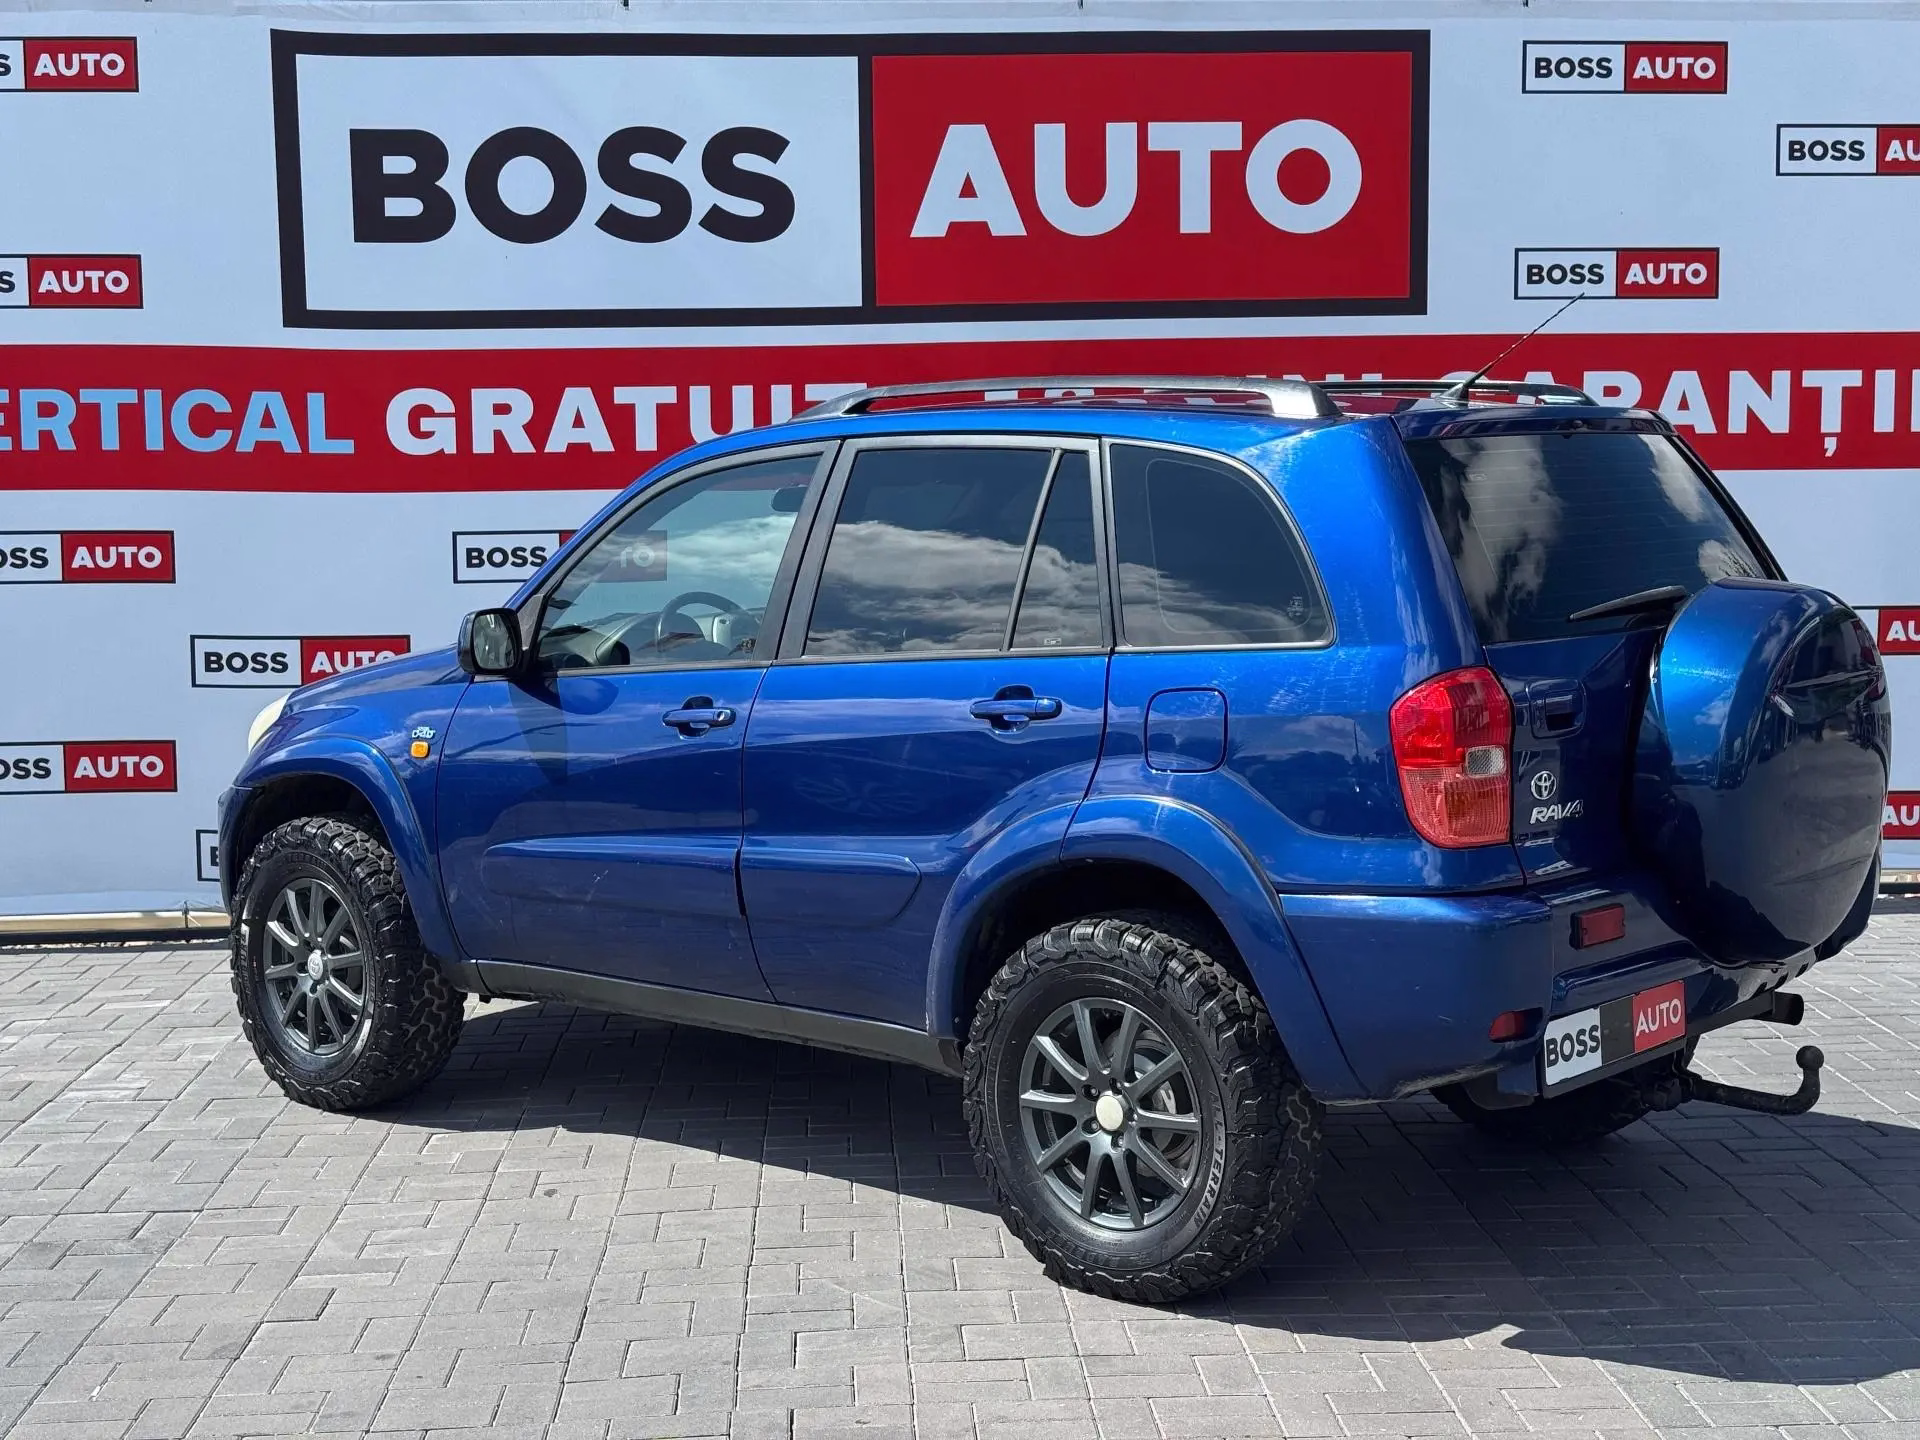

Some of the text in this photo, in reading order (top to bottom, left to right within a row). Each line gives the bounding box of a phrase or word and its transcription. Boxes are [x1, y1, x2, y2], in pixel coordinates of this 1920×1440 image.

[33, 53, 126, 77] AUTO
[1534, 56, 1717, 80] BOSS AUTO
[1788, 139, 1866, 162] BOSS
[349, 118, 1363, 244] BOSS AUTO
[38, 270, 130, 294] AUTO
[1526, 262, 1708, 286] BOSS AUTO
[71, 546, 163, 569] AUTO
[465, 546, 548, 569] BOSS
[204, 651, 289, 674] BOSS
[73, 755, 165, 779] AUTO
[1545, 998, 1683, 1069] BOSS AUTO
